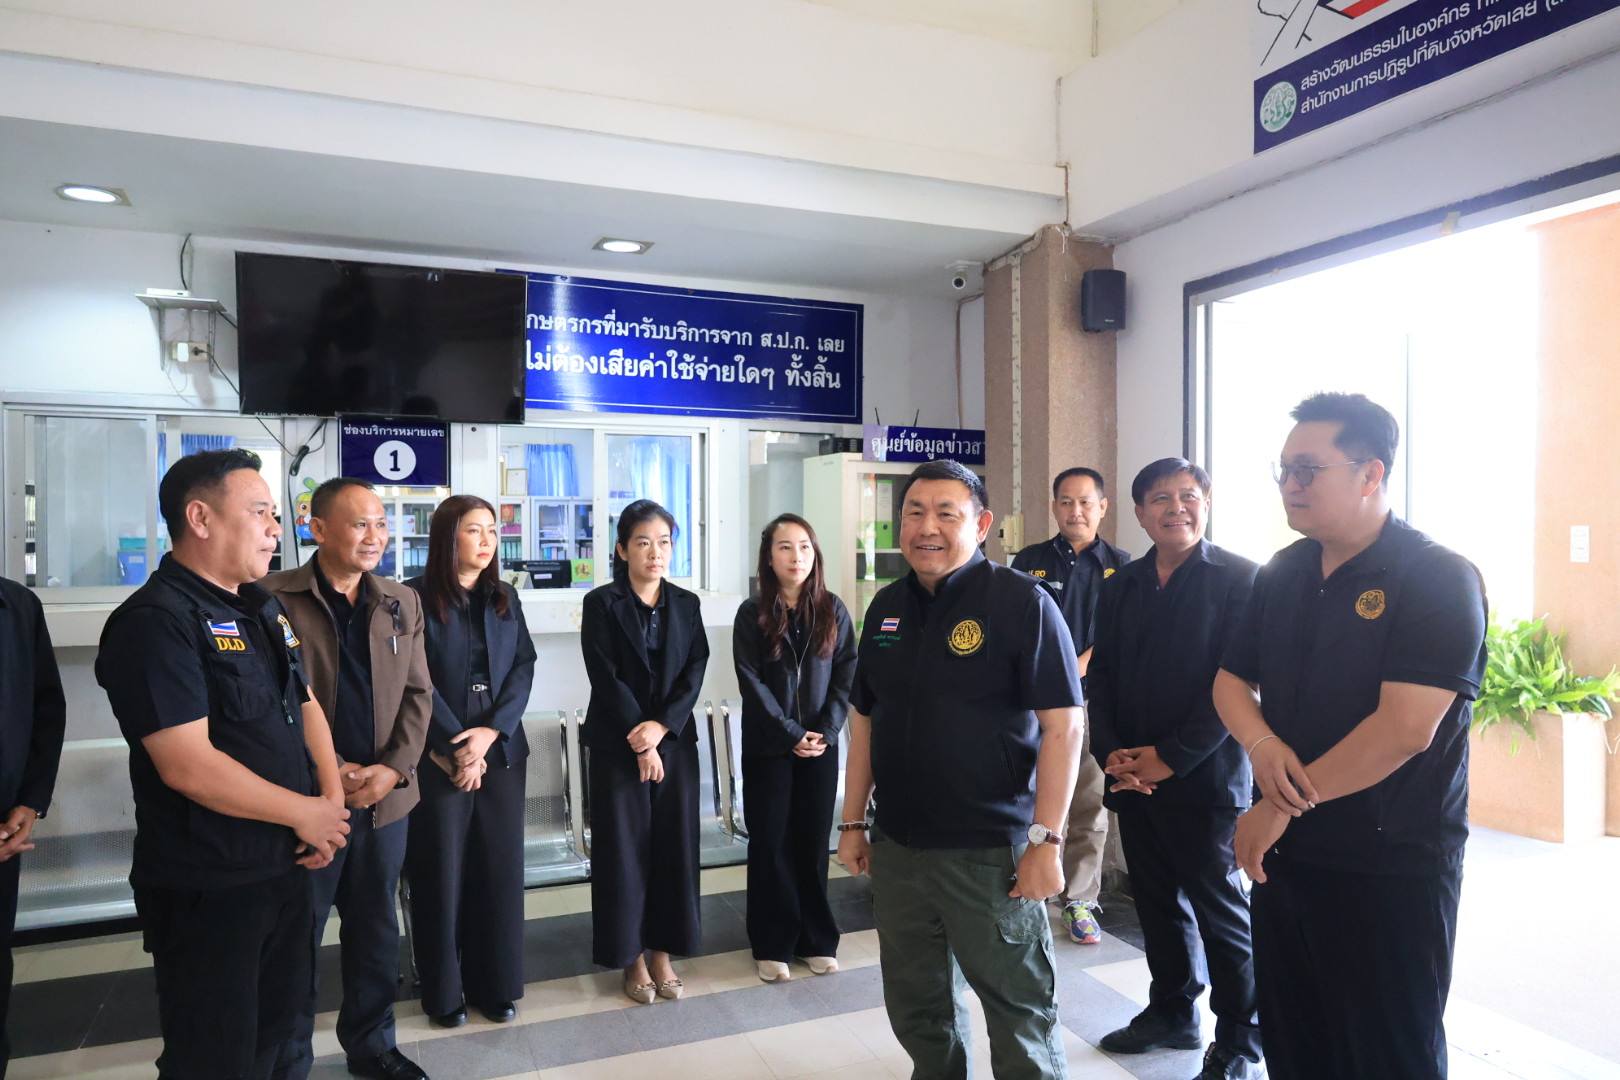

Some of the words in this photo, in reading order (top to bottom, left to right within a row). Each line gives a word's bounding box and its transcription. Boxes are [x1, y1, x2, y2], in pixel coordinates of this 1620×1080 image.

[1301, 2, 1472, 91] สร้างวัฒนธรรมในองค์กร
[761, 331, 809, 350] ส.ป.ก.
[818, 337, 845, 352] เลย
[785, 354, 841, 389] ทั้งสิ้น
[343, 424, 445, 437] ช่องบริการหมายเลข
[871, 429, 985, 460] ศูนย์ข้อมูลข่าวส
[389, 449, 401, 472] 1
[214, 637, 246, 651] DLD
